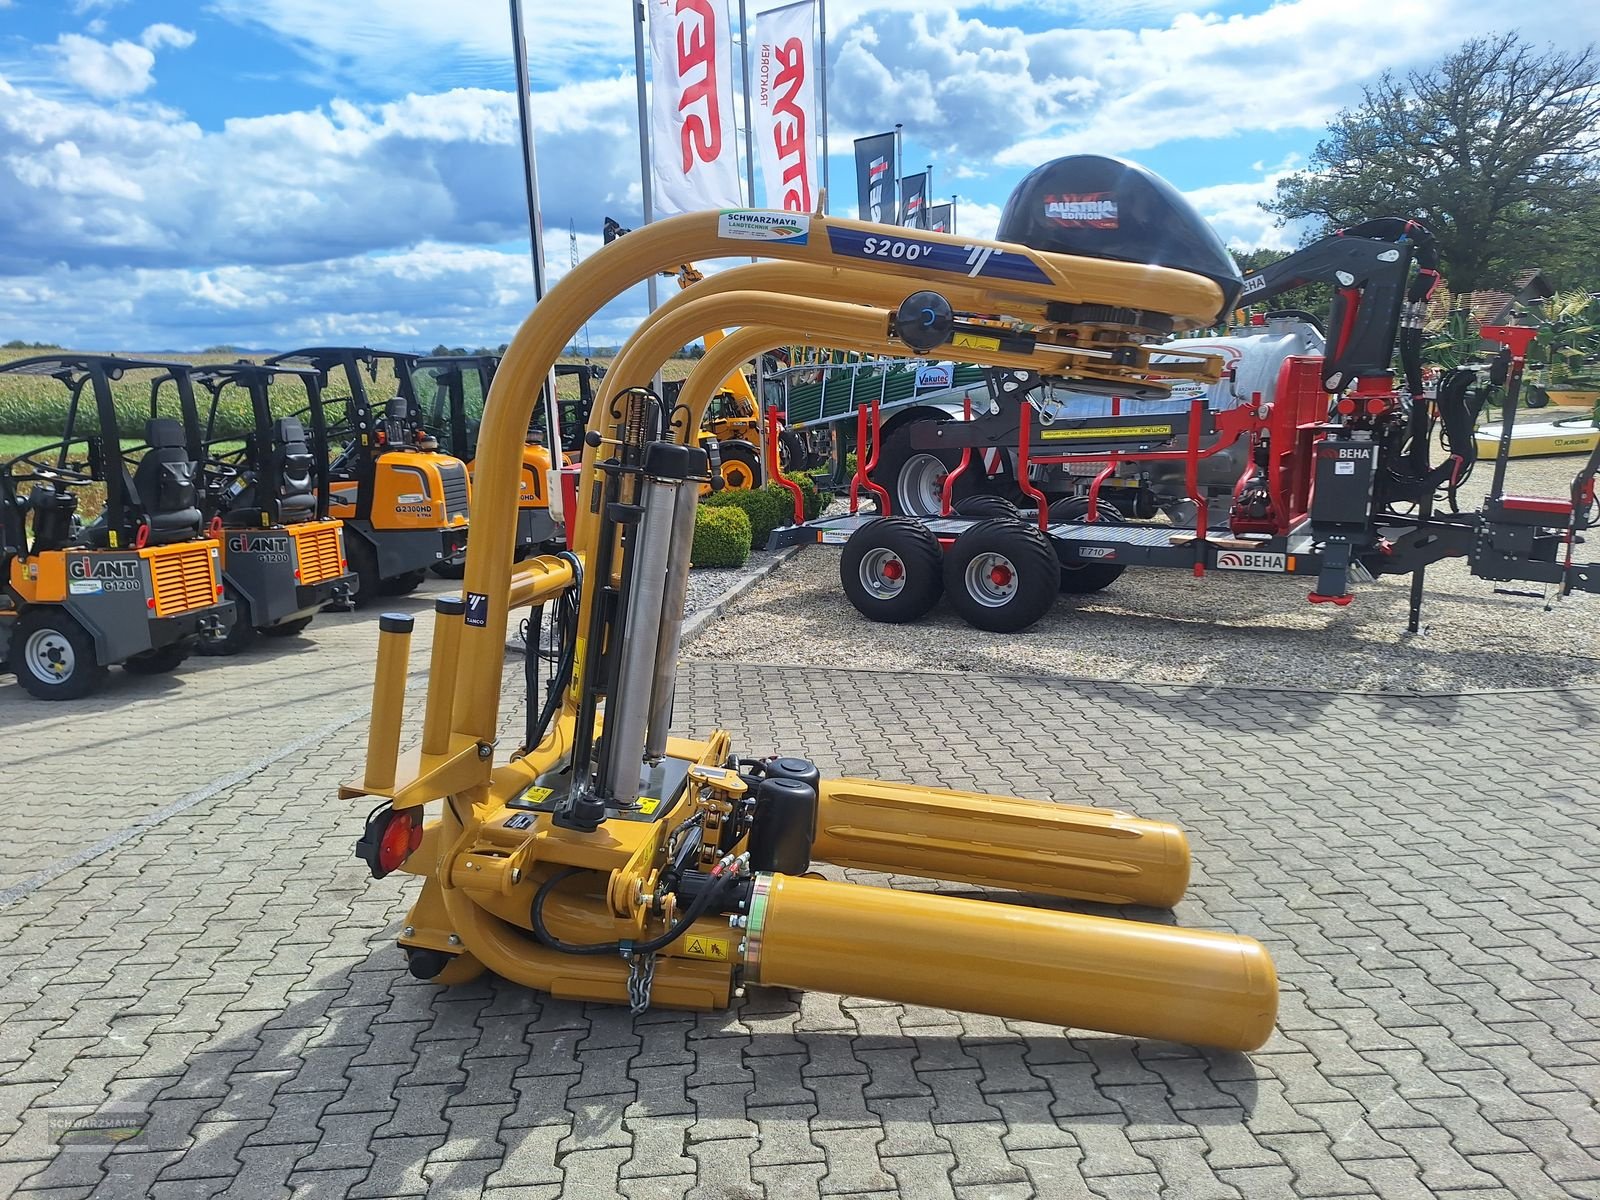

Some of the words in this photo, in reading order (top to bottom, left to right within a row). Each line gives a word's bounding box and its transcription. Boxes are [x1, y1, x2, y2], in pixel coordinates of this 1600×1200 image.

[1049, 201, 1114, 212] AUSTRIA
[727, 213, 797, 226] SCHWARZMAYR
[1061, 212, 1102, 220] EDITION
[728, 221, 769, 230] LANDTECHNIK
[1244, 278, 1265, 292] EHA
[919, 372, 949, 385] Vakutec
[1339, 448, 1370, 459] BEHA
[395, 505, 432, 513] G2300HD
[257, 553, 290, 563] G1200
[1243, 555, 1283, 569] BEHA
[103, 580, 141, 591] G1200
[466, 617, 485, 625] TANCO
